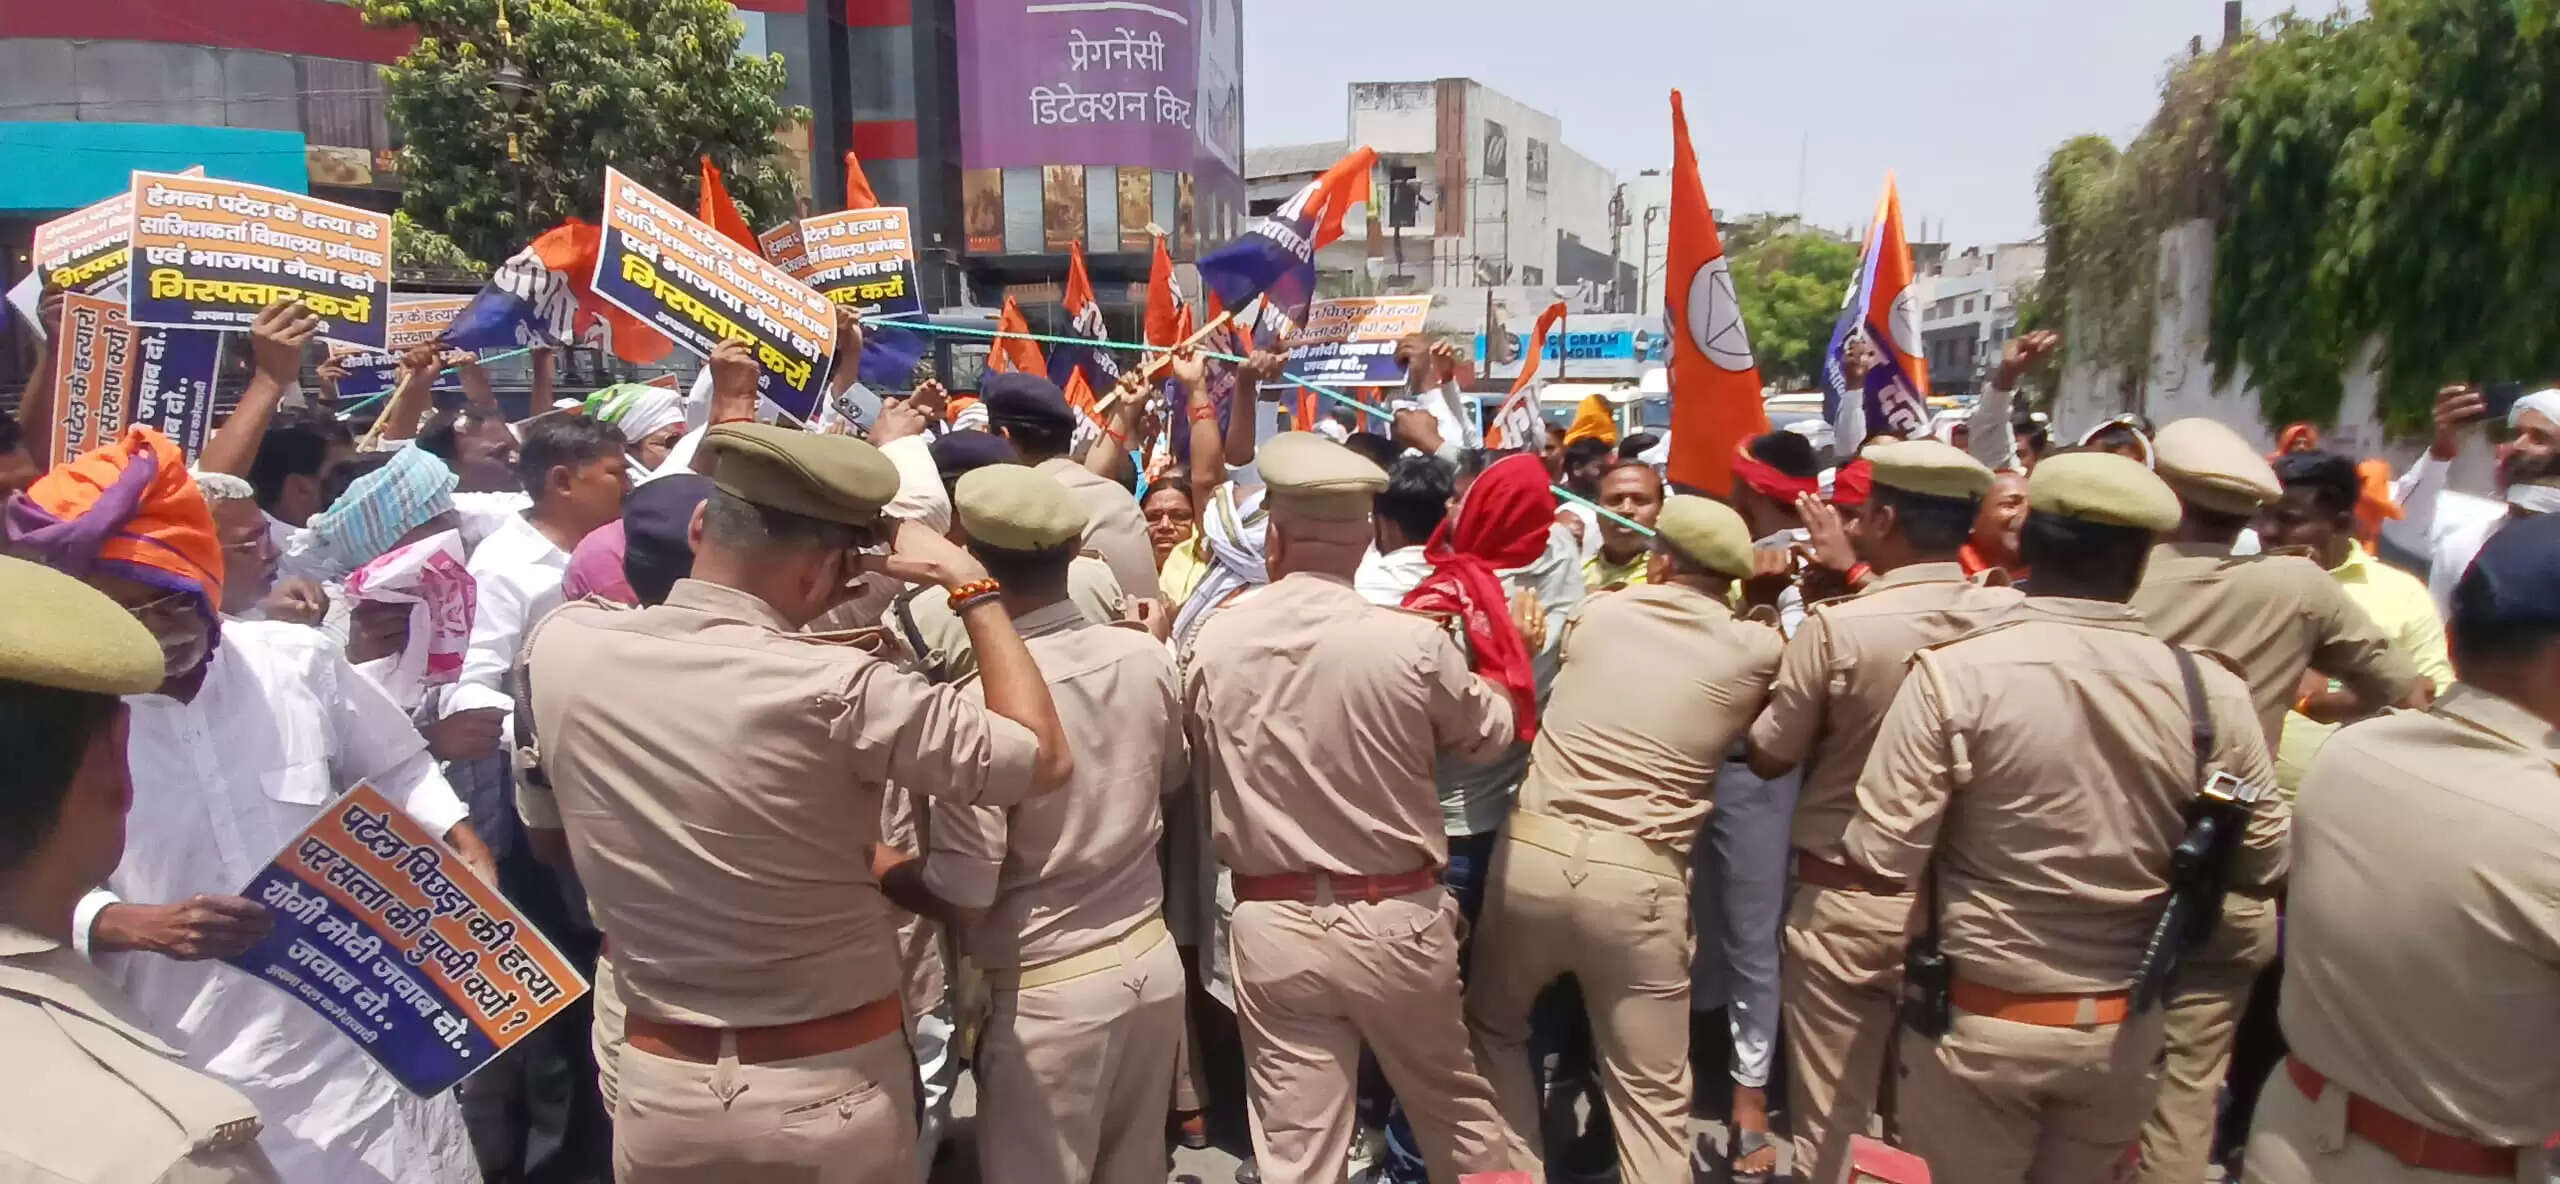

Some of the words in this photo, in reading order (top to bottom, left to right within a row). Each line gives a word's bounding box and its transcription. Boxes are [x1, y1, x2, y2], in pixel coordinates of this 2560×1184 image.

[1068, 28, 1165, 71] प्रेगनेंसी
[1029, 82, 1148, 125] डिटेक्शन
[1154, 85, 1192, 129] किट
[140, 212, 248, 241] साजिशकर्ता
[147, 183, 214, 210] हेमन्त
[218, 194, 270, 217] पटेल
[272, 203, 299, 222] के
[302, 210, 353, 235] हत्या
[355, 221, 378, 239] के
[52, 248, 129, 288] गिरफ्ता
[147, 242, 187, 265] एवं
[190, 249, 281, 274] भाजपा
[283, 257, 337, 284] नेता
[340, 272, 377, 293] को
[108, 309, 125, 321] ?
[661, 256, 742, 313] भाजपा
[745, 303, 792, 342] नेता
[791, 331, 821, 364] को
[1570, 334, 1619, 345] CREAM
[299, 837, 340, 871] पर
[326, 857, 395, 912] सत्ता
[342, 804, 411, 859] पटेल
[395, 846, 478, 920] पिछड़ा
[466, 911, 516, 952] की
[498, 943, 563, 1005] हत्या
[384, 900, 431, 938] की
[263, 879, 329, 925] योगी
[316, 914, 382, 964] मोदी
[372, 956, 441, 1018] जवाब
[288, 938, 362, 994] जवाब
[405, 928, 479, 980] चुप्पी
[501, 1010, 529, 1033] ?
